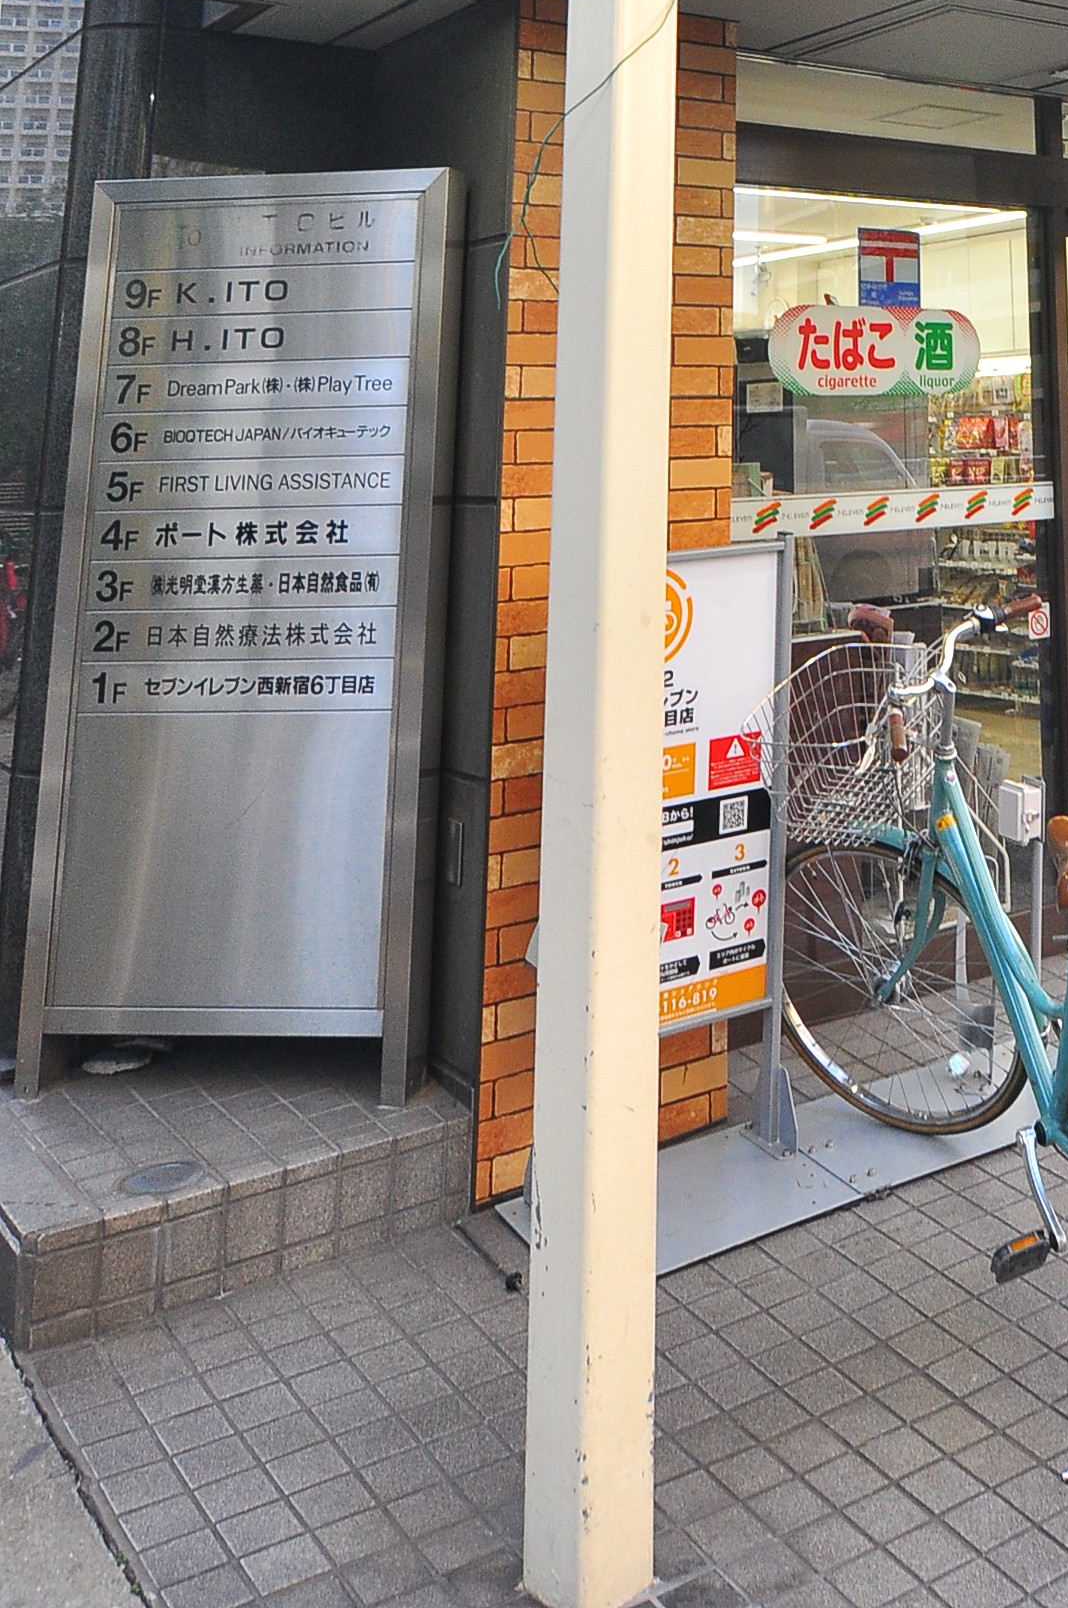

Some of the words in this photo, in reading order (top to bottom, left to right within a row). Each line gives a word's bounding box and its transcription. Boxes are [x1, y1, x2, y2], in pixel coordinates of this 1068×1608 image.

[125, 279, 162, 309] 9F
[118, 326, 155, 357] 8F
[797, 317, 895, 371] たばこ
[914, 320, 954, 371] 酒
[115, 374, 151, 404] 7F
[817, 373, 877, 390] cigarette
[918, 374, 955, 389] liquor
[110, 421, 148, 454] 6F
[106, 471, 143, 502] 5F
[159, 476, 209, 493] FIRST
[215, 475, 273, 492] LIVING
[278, 472, 391, 490] ASSISTANCE
[100, 520, 139, 551] 4F
[155, 519, 349, 547] ポート株式会社
[95, 570, 134, 602] 3F
[93, 620, 130, 652] 2F
[147, 622, 377, 648] 日本自然療法株式会社
[92, 672, 127, 704] 1F
[144, 675, 375, 697] セブンイレブン西新宿6丁目店
[664, 708, 694, 727] 目店
[669, 858, 679, 876] 2
[735, 843, 745, 861] 3
